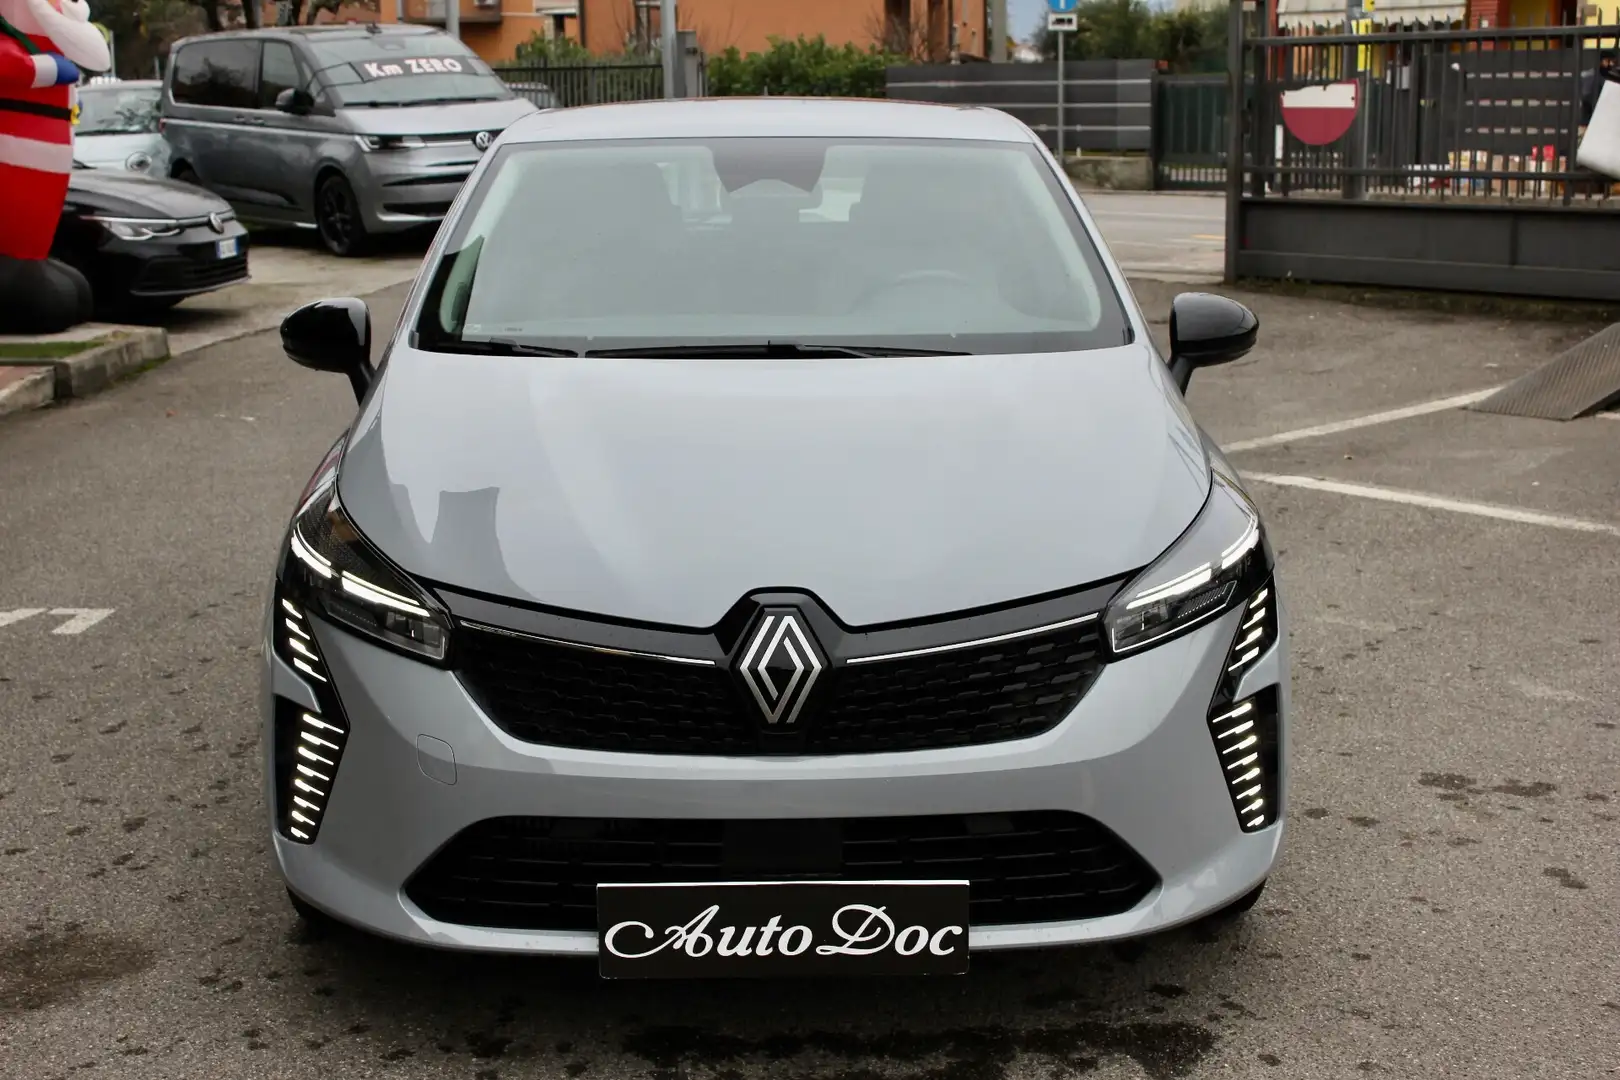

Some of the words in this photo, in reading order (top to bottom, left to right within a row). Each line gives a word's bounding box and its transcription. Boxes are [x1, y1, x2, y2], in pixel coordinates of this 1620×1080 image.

[364, 63, 404, 77] Km
[404, 58, 463, 73] ZERO
[604, 904, 813, 959] Auto
[815, 903, 963, 956] Doc
